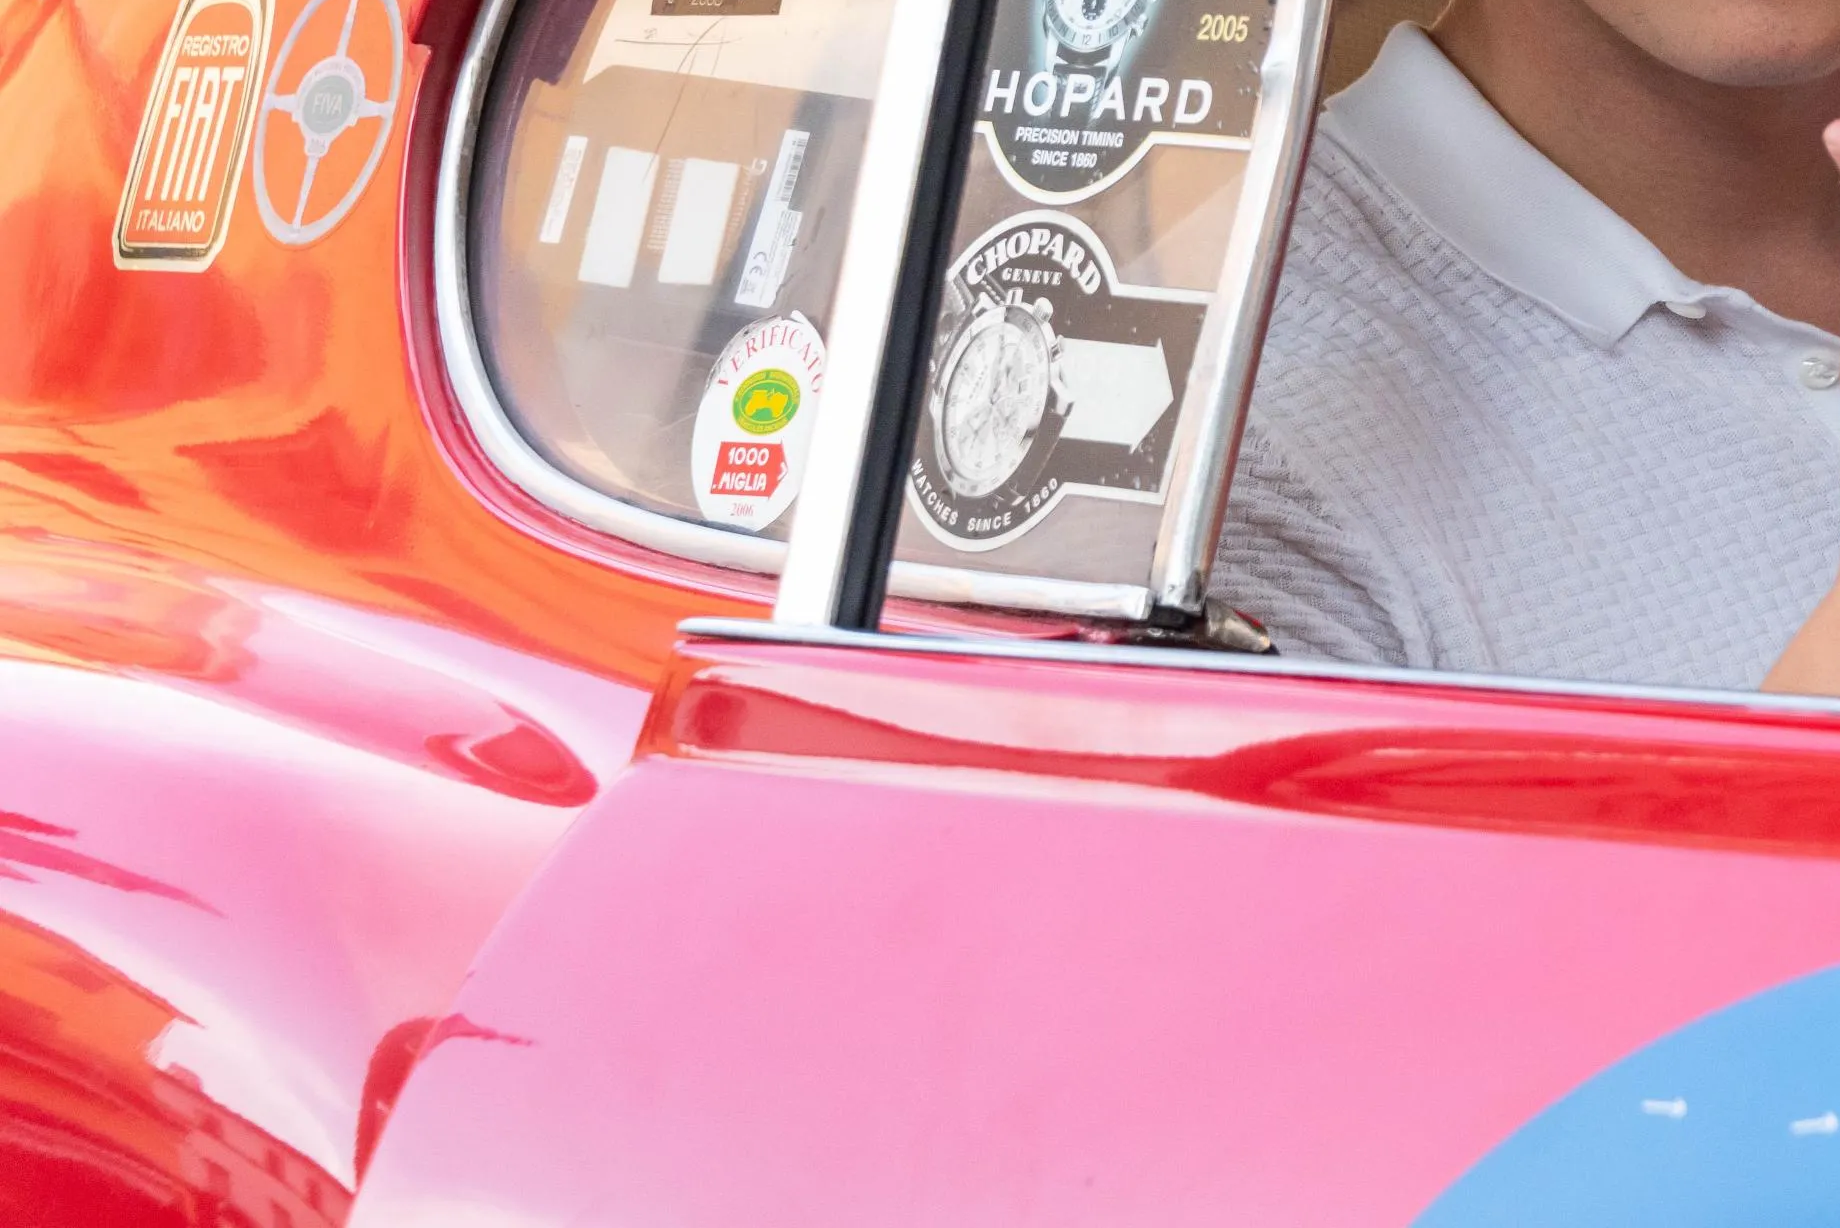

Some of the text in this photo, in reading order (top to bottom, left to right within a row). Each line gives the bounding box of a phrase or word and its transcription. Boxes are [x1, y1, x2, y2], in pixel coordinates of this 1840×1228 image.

[1196, 14, 1250, 42] 2005
[181, 35, 250, 57] REGISTRO
[311, 92, 343, 116] FIVA
[983, 69, 1214, 125] HOPARD
[143, 66, 245, 202] FIAT
[1015, 126, 1125, 148] PRECISION TIMING
[1031, 149, 1098, 168] SINCE 1860
[136, 209, 206, 233] ITALIANO
[966, 228, 1101, 295] CHOPARD
[728, 447, 770, 466] 1000
[716, 471, 767, 491] MIGLIA
[911, 458, 1059, 532] WATCHES SINCE 1860
